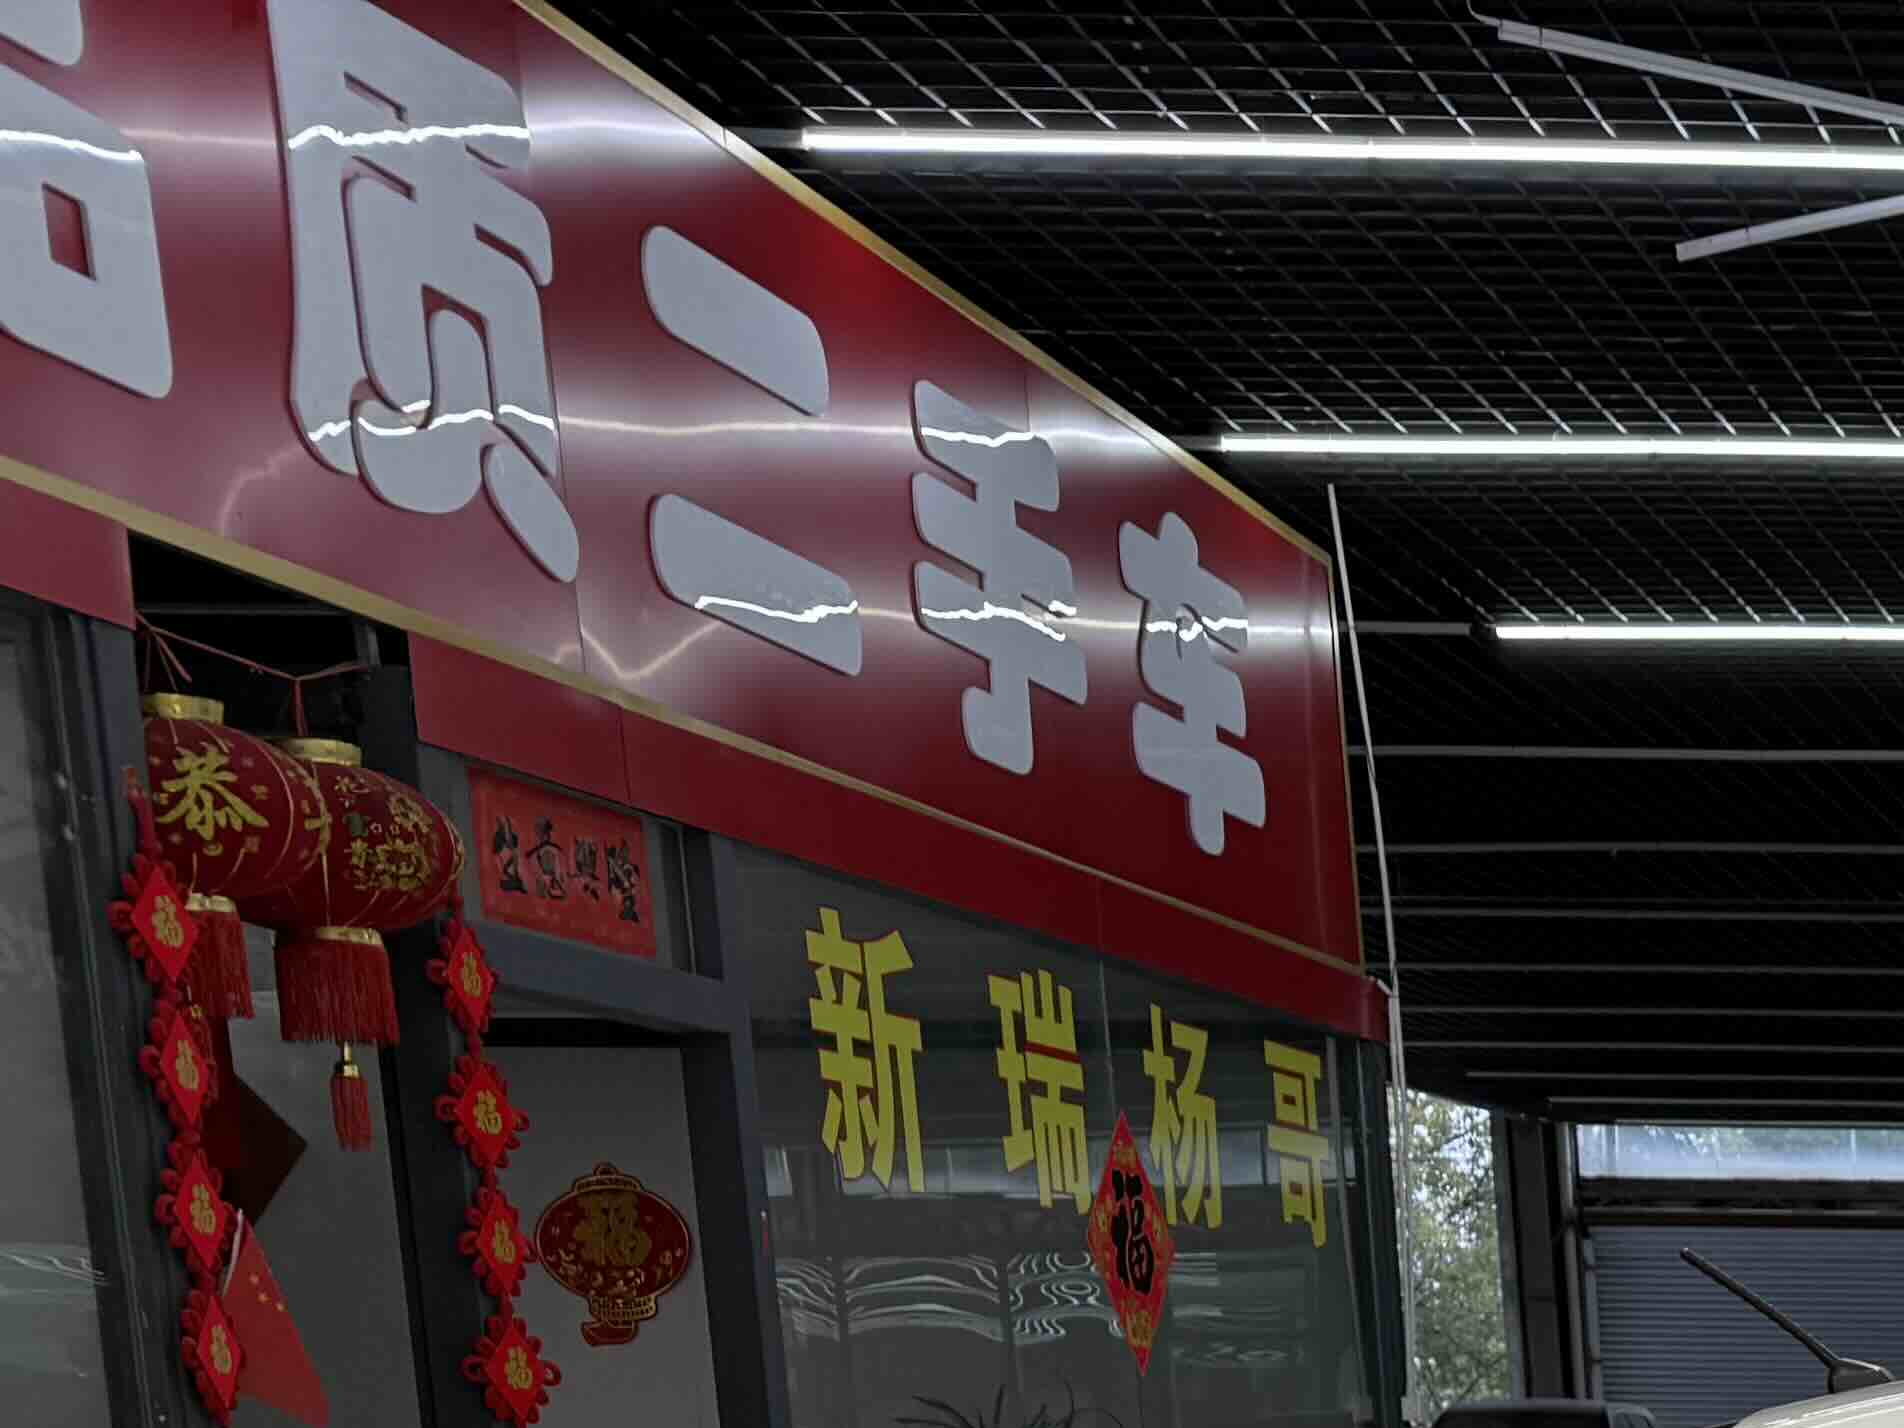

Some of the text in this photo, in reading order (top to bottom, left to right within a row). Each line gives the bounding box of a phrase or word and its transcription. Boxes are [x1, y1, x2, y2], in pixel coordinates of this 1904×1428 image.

[0, 0, 1266, 856] 质二手车
[157, 744, 269, 841] 恭
[805, 906, 1328, 1248] 新瑞杨哥
[1111, 1169, 1154, 1294] 福
